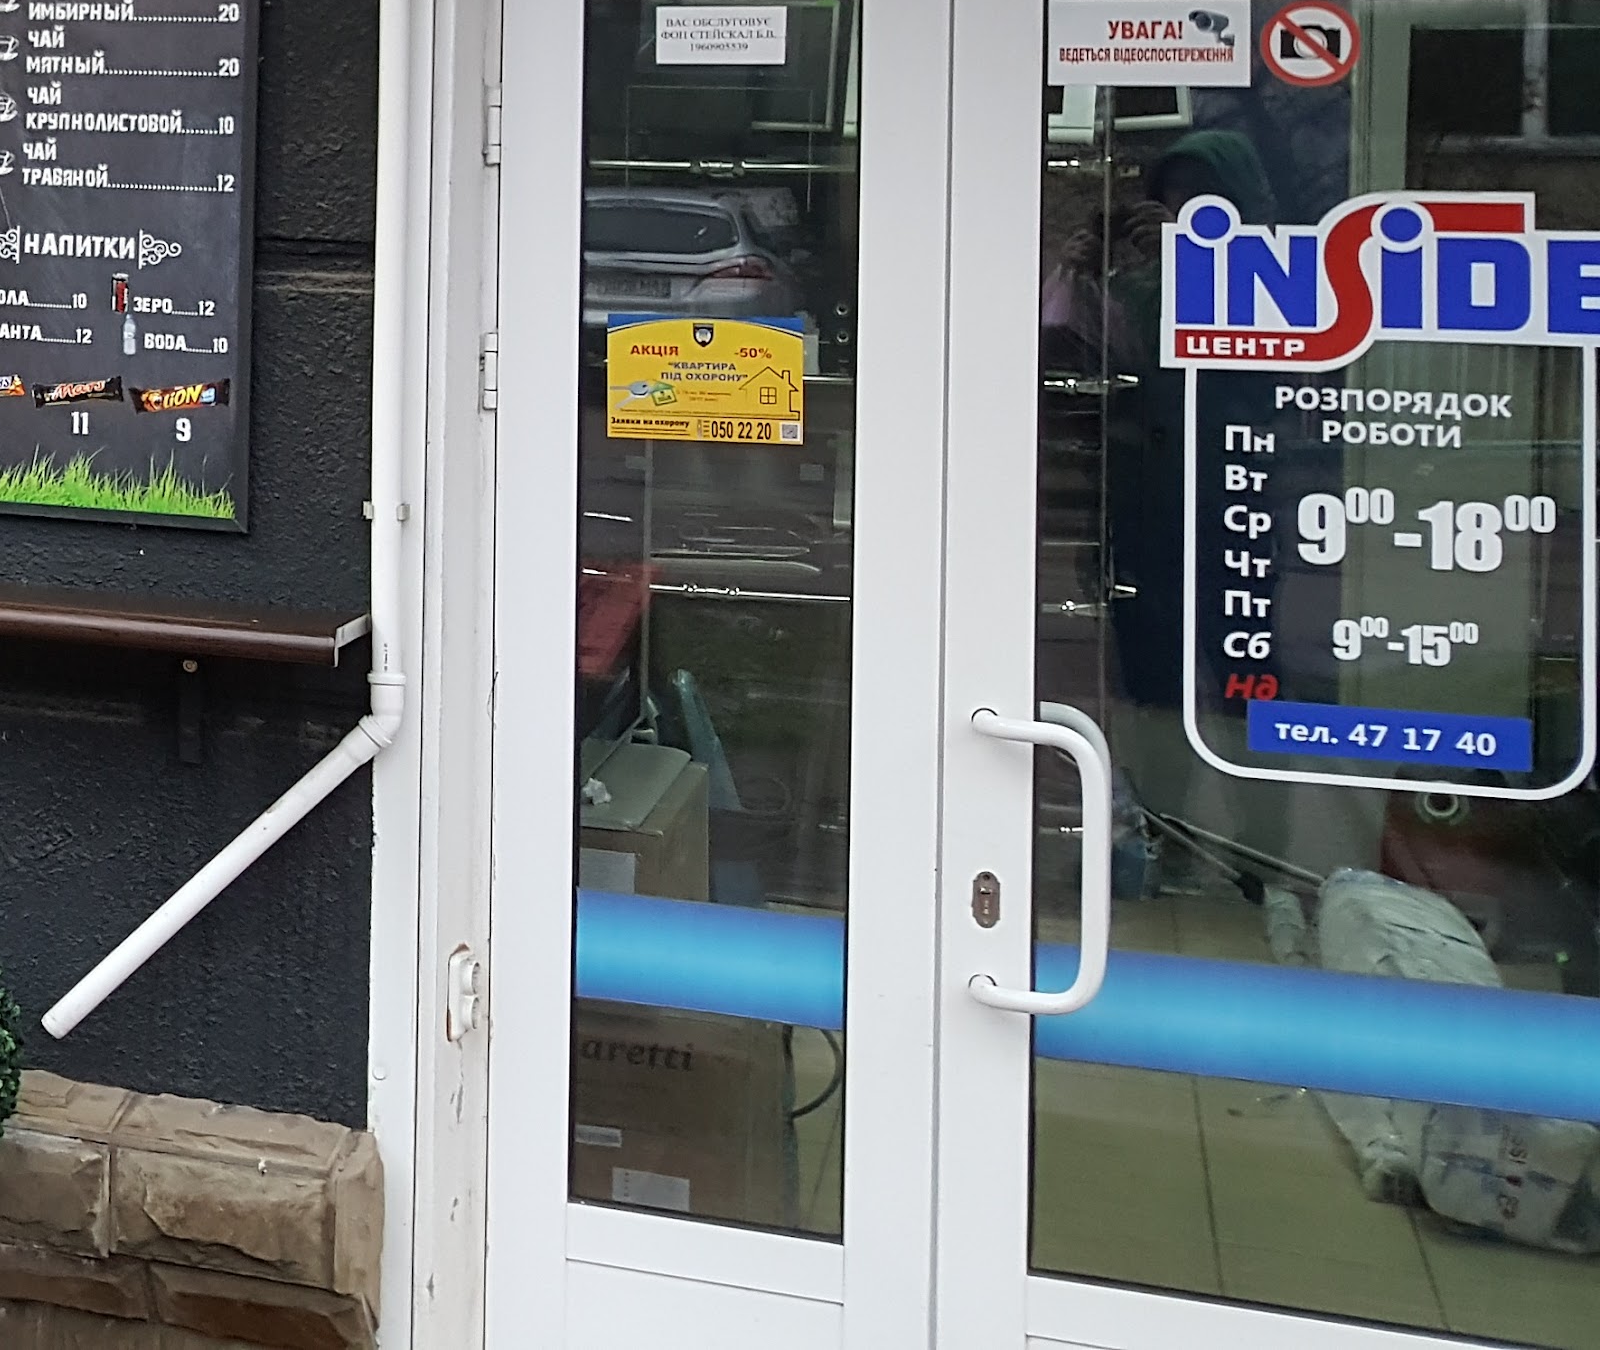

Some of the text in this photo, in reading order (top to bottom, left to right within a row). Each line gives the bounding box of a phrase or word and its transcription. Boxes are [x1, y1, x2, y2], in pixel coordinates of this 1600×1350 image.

[27, 24, 65, 49] ЧАЙ
[1108, 20, 1184, 40] УВАГА!
[1059, 48, 1234, 63] ВЕДЕТЬСЯ ВІДЕОСПОСТЕРЕЖЕННЯ
[27, 80, 62, 105] ЧАЙ
[23, 136, 57, 161] ЧАЙ
[24, 232, 136, 259] НАПИТКИ
[630, 345, 773, 359] АКЦІЯ -50%
[1186, 336, 1306, 356] ЦЕНТР
[661, 372, 682, 381] ПІД
[1274, 386, 1512, 420] РОЗПОРЯДОК
[71, 411, 89, 435] 11
[175, 417, 191, 441] 9
[711, 421, 772, 440] 050 22 20
[1322, 420, 1461, 449] РОБОТИ
[1225, 425, 1275, 453] Пн
[1225, 464, 1268, 492] Вт
[1223, 505, 1272, 540] Ср
[1223, 550, 1271, 579] Чт
[1223, 590, 1271, 619] Пт
[1223, 631, 1272, 660] Сб
[1274, 722, 1497, 757] тел. 47 17 40
